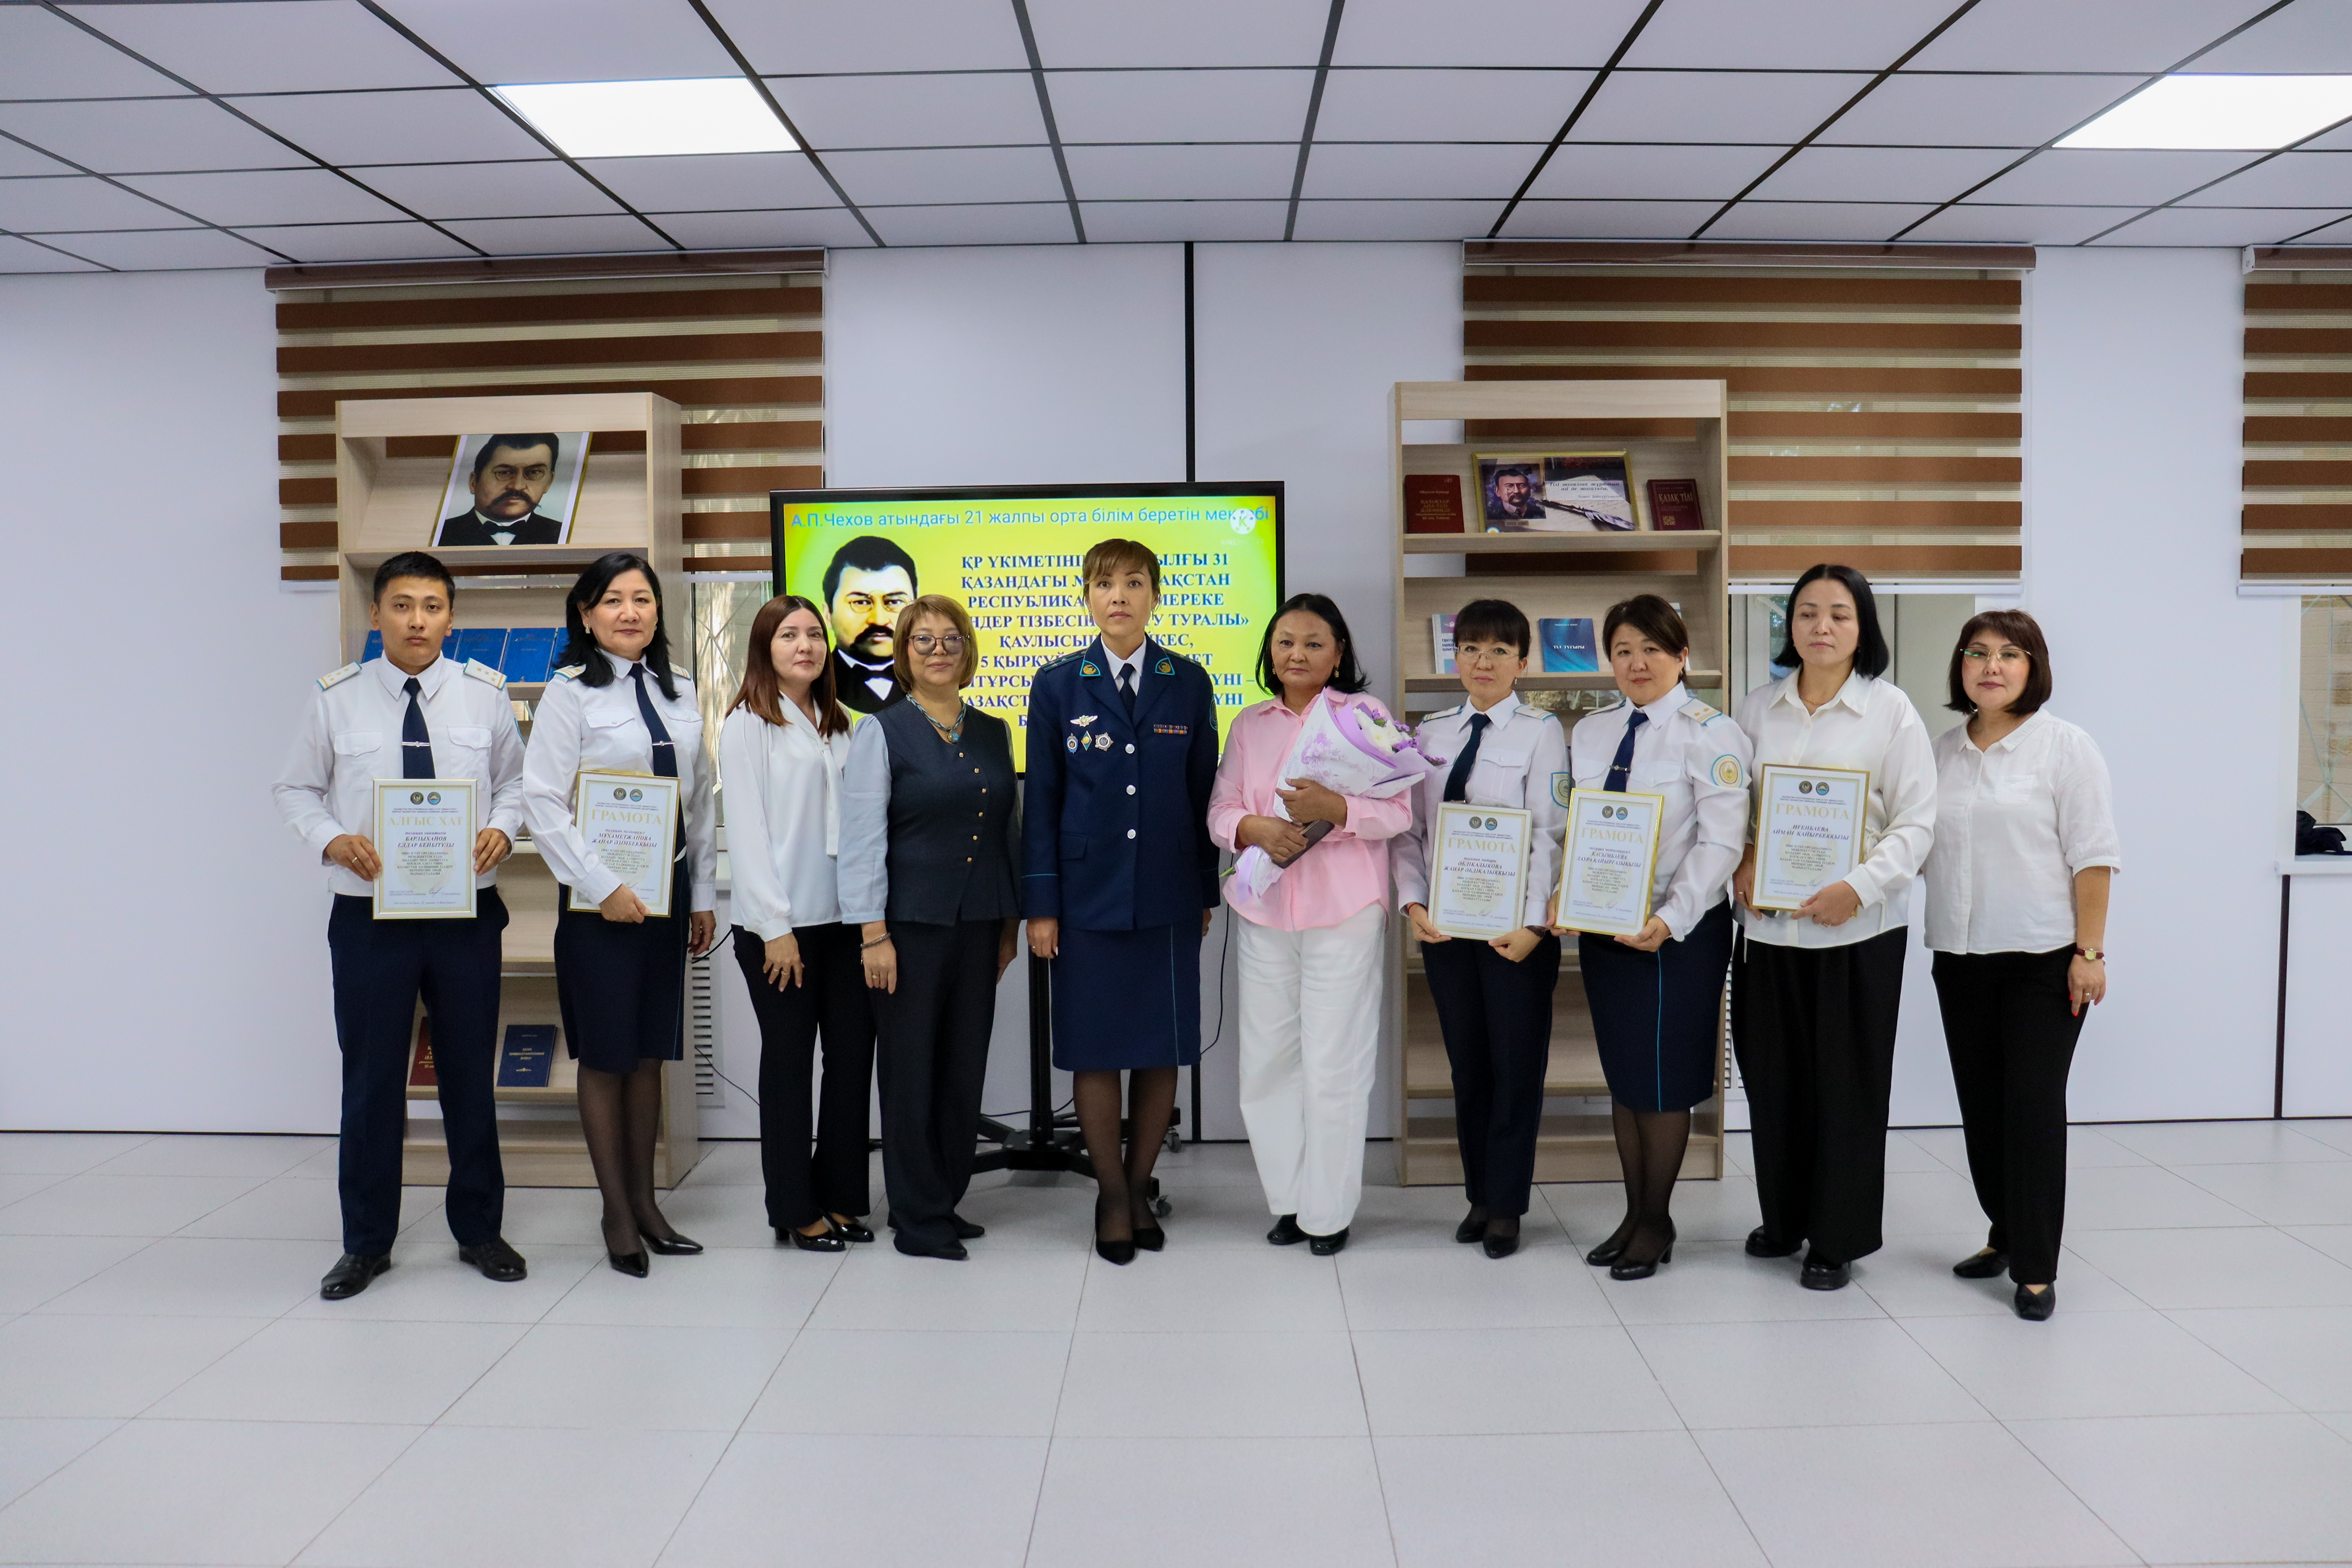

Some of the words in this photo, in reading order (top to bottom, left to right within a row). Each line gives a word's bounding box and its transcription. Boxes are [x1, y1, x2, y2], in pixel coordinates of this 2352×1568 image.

[1658, 494, 1679, 504] ҚАЗАҚ
[1680, 492, 1693, 501] ТІЛІ
[878, 512, 959, 527] атындағы
[965, 510, 982, 524] 21
[989, 511, 1044, 524] жалпы
[1050, 510, 1087, 525] орта
[1092, 508, 1133, 522] білім
[1138, 507, 1200, 524] беретін
[961, 556, 983, 570] ҚР
[988, 555, 1086, 568] ҮКІМЕТІНІ
[1154, 553, 1207, 566] ЫЛҒЫ
[1213, 553, 1228, 565] 31
[961, 575, 1067, 591] ҚАЗАНДАҒЫ
[1161, 574, 1230, 588] АҚСТАН
[968, 595, 1084, 608] РЕСПУБЛИКА
[970, 615, 1012, 630] НДЕР
[1168, 613, 1249, 626] ТУРАЛЫ»
[1209, 673, 1242, 685] ҮНІ
[592, 809, 662, 824] ГРАМОТА
[1776, 803, 1849, 820] ГРАМОТА
[387, 817, 435, 826] АЛҒЫС
[439, 817, 463, 826] ХАТ
[1581, 828, 1644, 843] ГРАМОТА
[1448, 837, 1516, 853] ГРАМОТА
